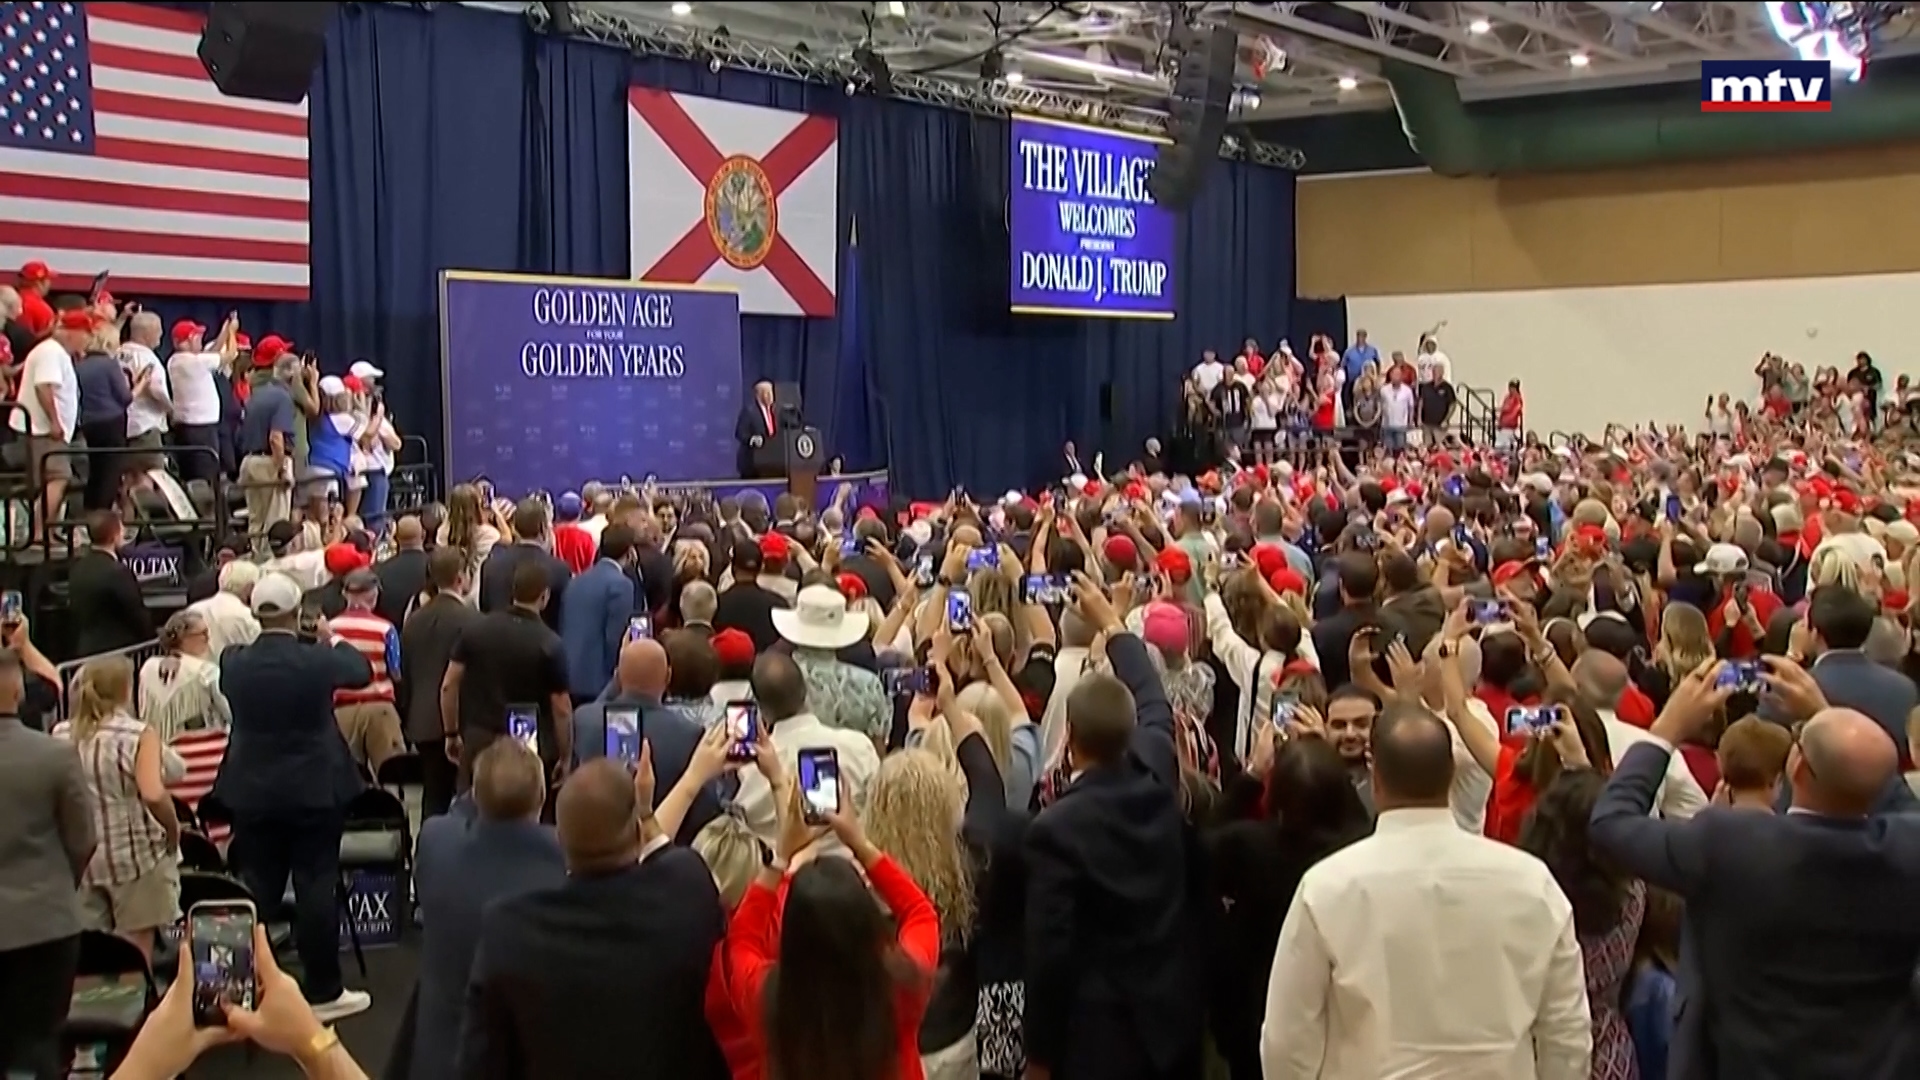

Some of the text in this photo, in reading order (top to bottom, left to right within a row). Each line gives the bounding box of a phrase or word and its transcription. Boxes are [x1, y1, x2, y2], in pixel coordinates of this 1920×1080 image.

[1020, 139, 1068, 193] THE
[1059, 200, 1136, 238] WELCOMES
[1022, 251, 1167, 302] DONALD J. TRUMP
[534, 288, 673, 328] GOLDEN AGE
[521, 341, 684, 377] GOLDEN YEARS
[147, 556, 178, 577] TAX
